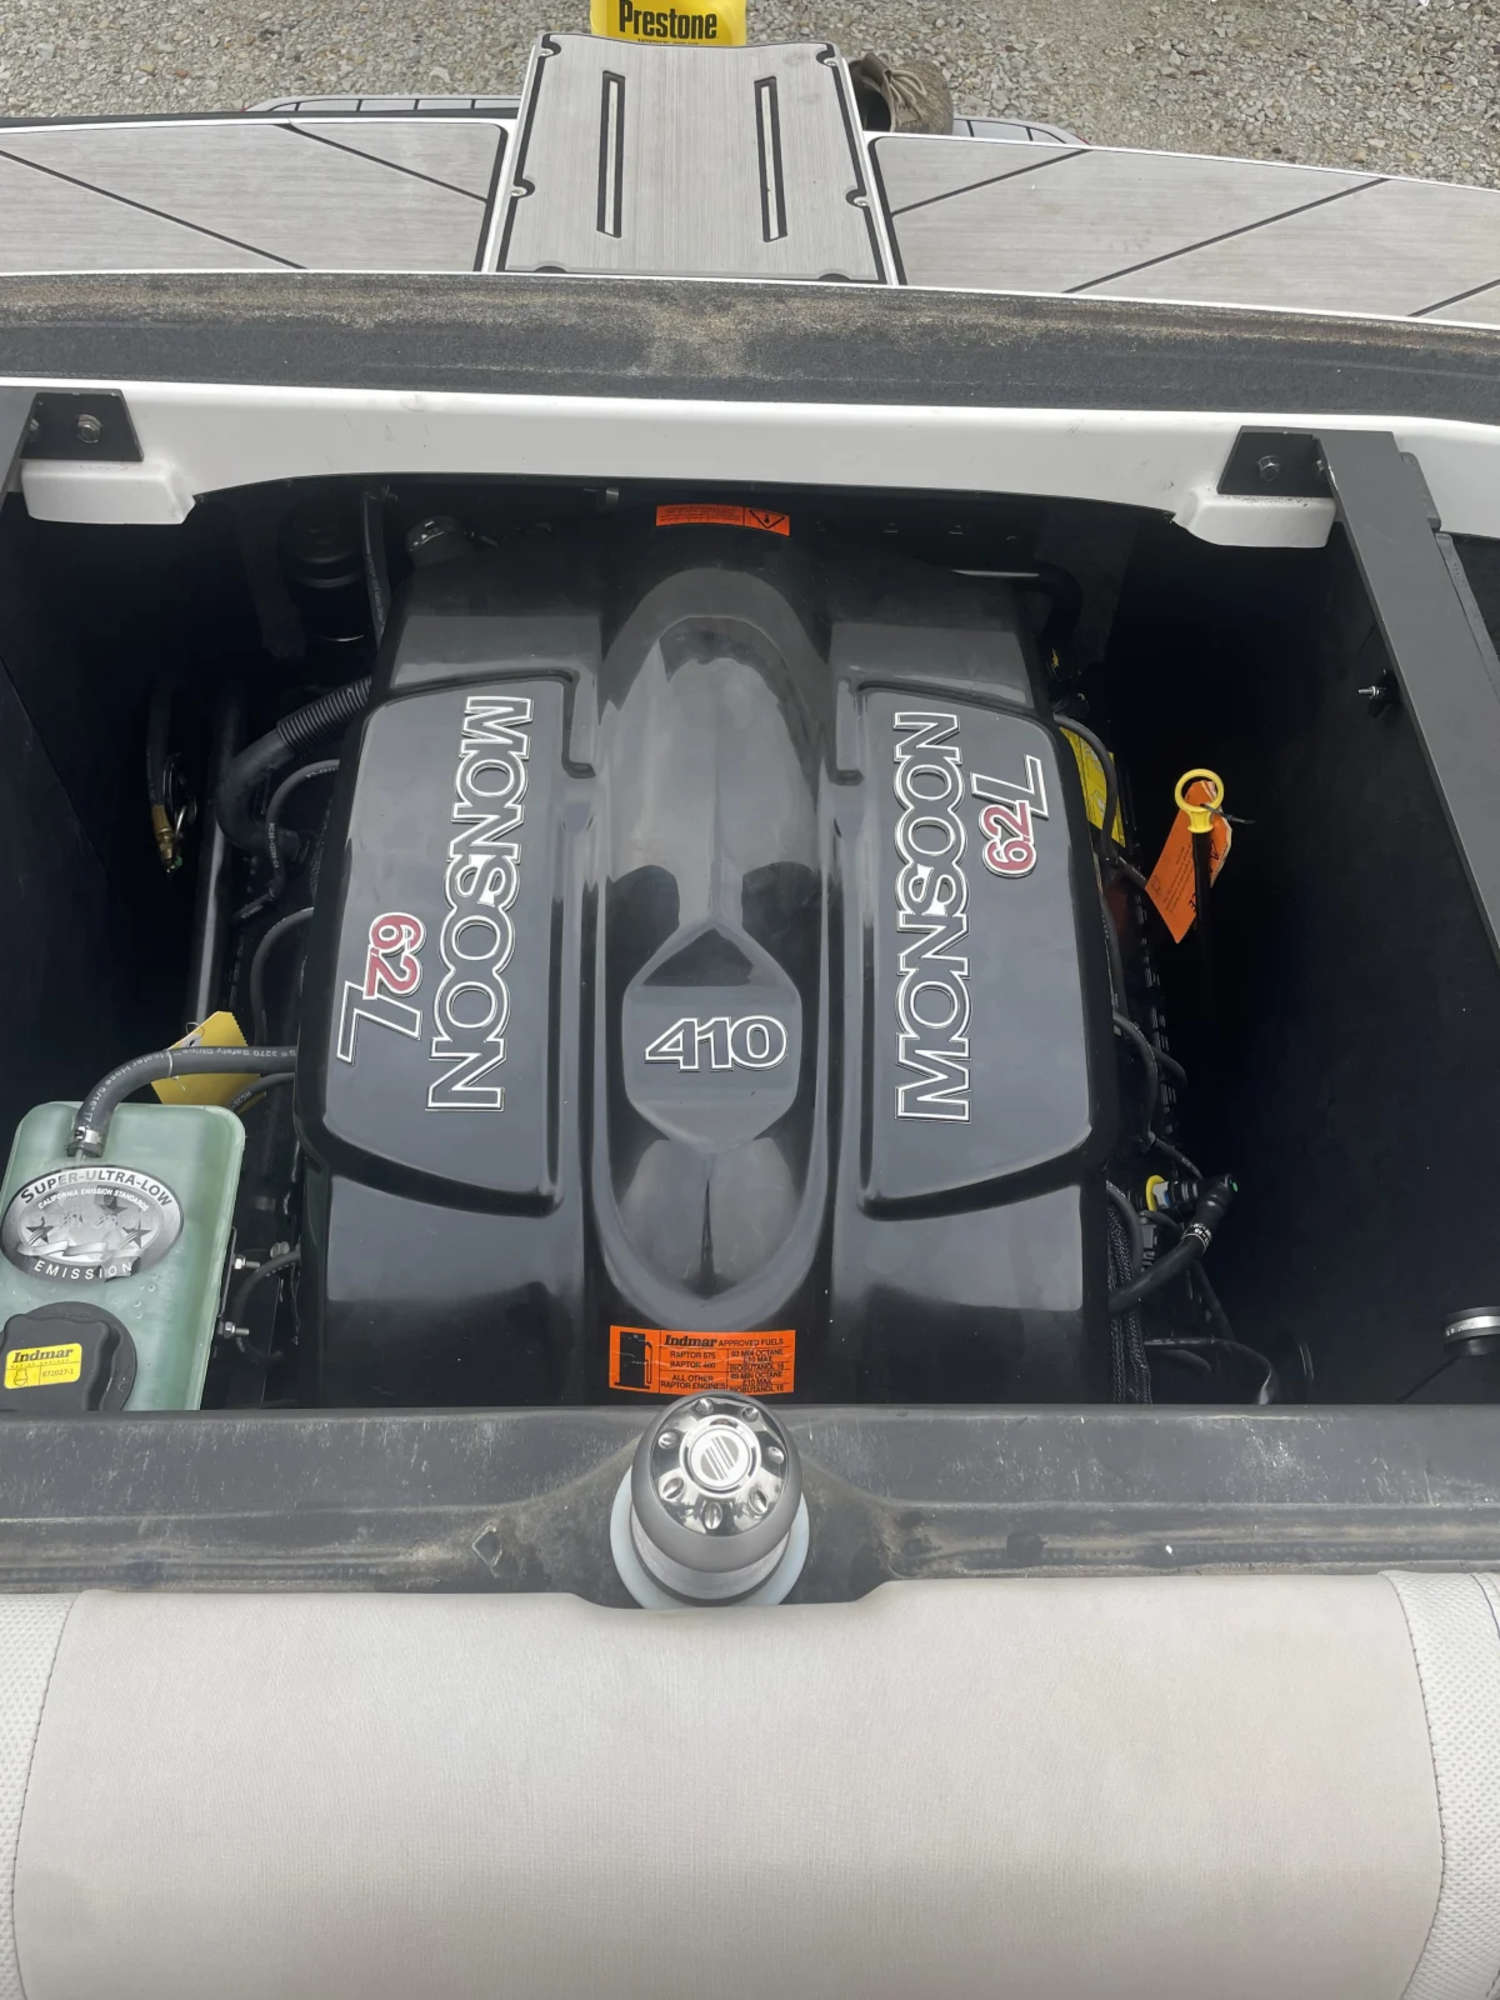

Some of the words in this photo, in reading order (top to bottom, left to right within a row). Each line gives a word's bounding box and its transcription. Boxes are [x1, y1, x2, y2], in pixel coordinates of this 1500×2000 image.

[618, 0, 718, 40] Prestone
[425, 695, 533, 1111] MONSOON
[893, 711, 973, 1123] MONSOON
[644, 1014, 788, 1072] 410
[215, 1047, 251, 1057] Safety
[252, 1049, 279, 1057] 3270
[110, 1064, 132, 1081] Hose
[20, 1169, 173, 1207] SUPER-ULTRA-LOW
[38, 1189, 78, 1209] CALIFORNIA
[80, 1188, 113, 1196] EMISSION
[114, 1189, 150, 1212] STANDARDS
[34, 1260, 132, 1280] EMISSION
[664, 1334, 718, 1347] Indmar
[718, 1339, 760, 1347] APPROVED
[760, 1338, 784, 1346] FUELS
[12, 1348, 74, 1364] Indmar
[670, 1350, 702, 1359] RAPTOR
[703, 1351, 716, 1360] 575
[740, 1349, 754, 1357] MIN
[755, 1348, 784, 1357] OCTANE
[670, 1360, 702, 1369] RAPTOR
[672, 1374, 687, 1382] ALL
[687, 1374, 714, 1382] OTHER
[740, 1372, 754, 1380] MIN
[754, 1370, 783, 1379] OCTANE
[660, 1380, 691, 1389] RAPTOR
[692, 1382, 726, 1390] ENGINES
